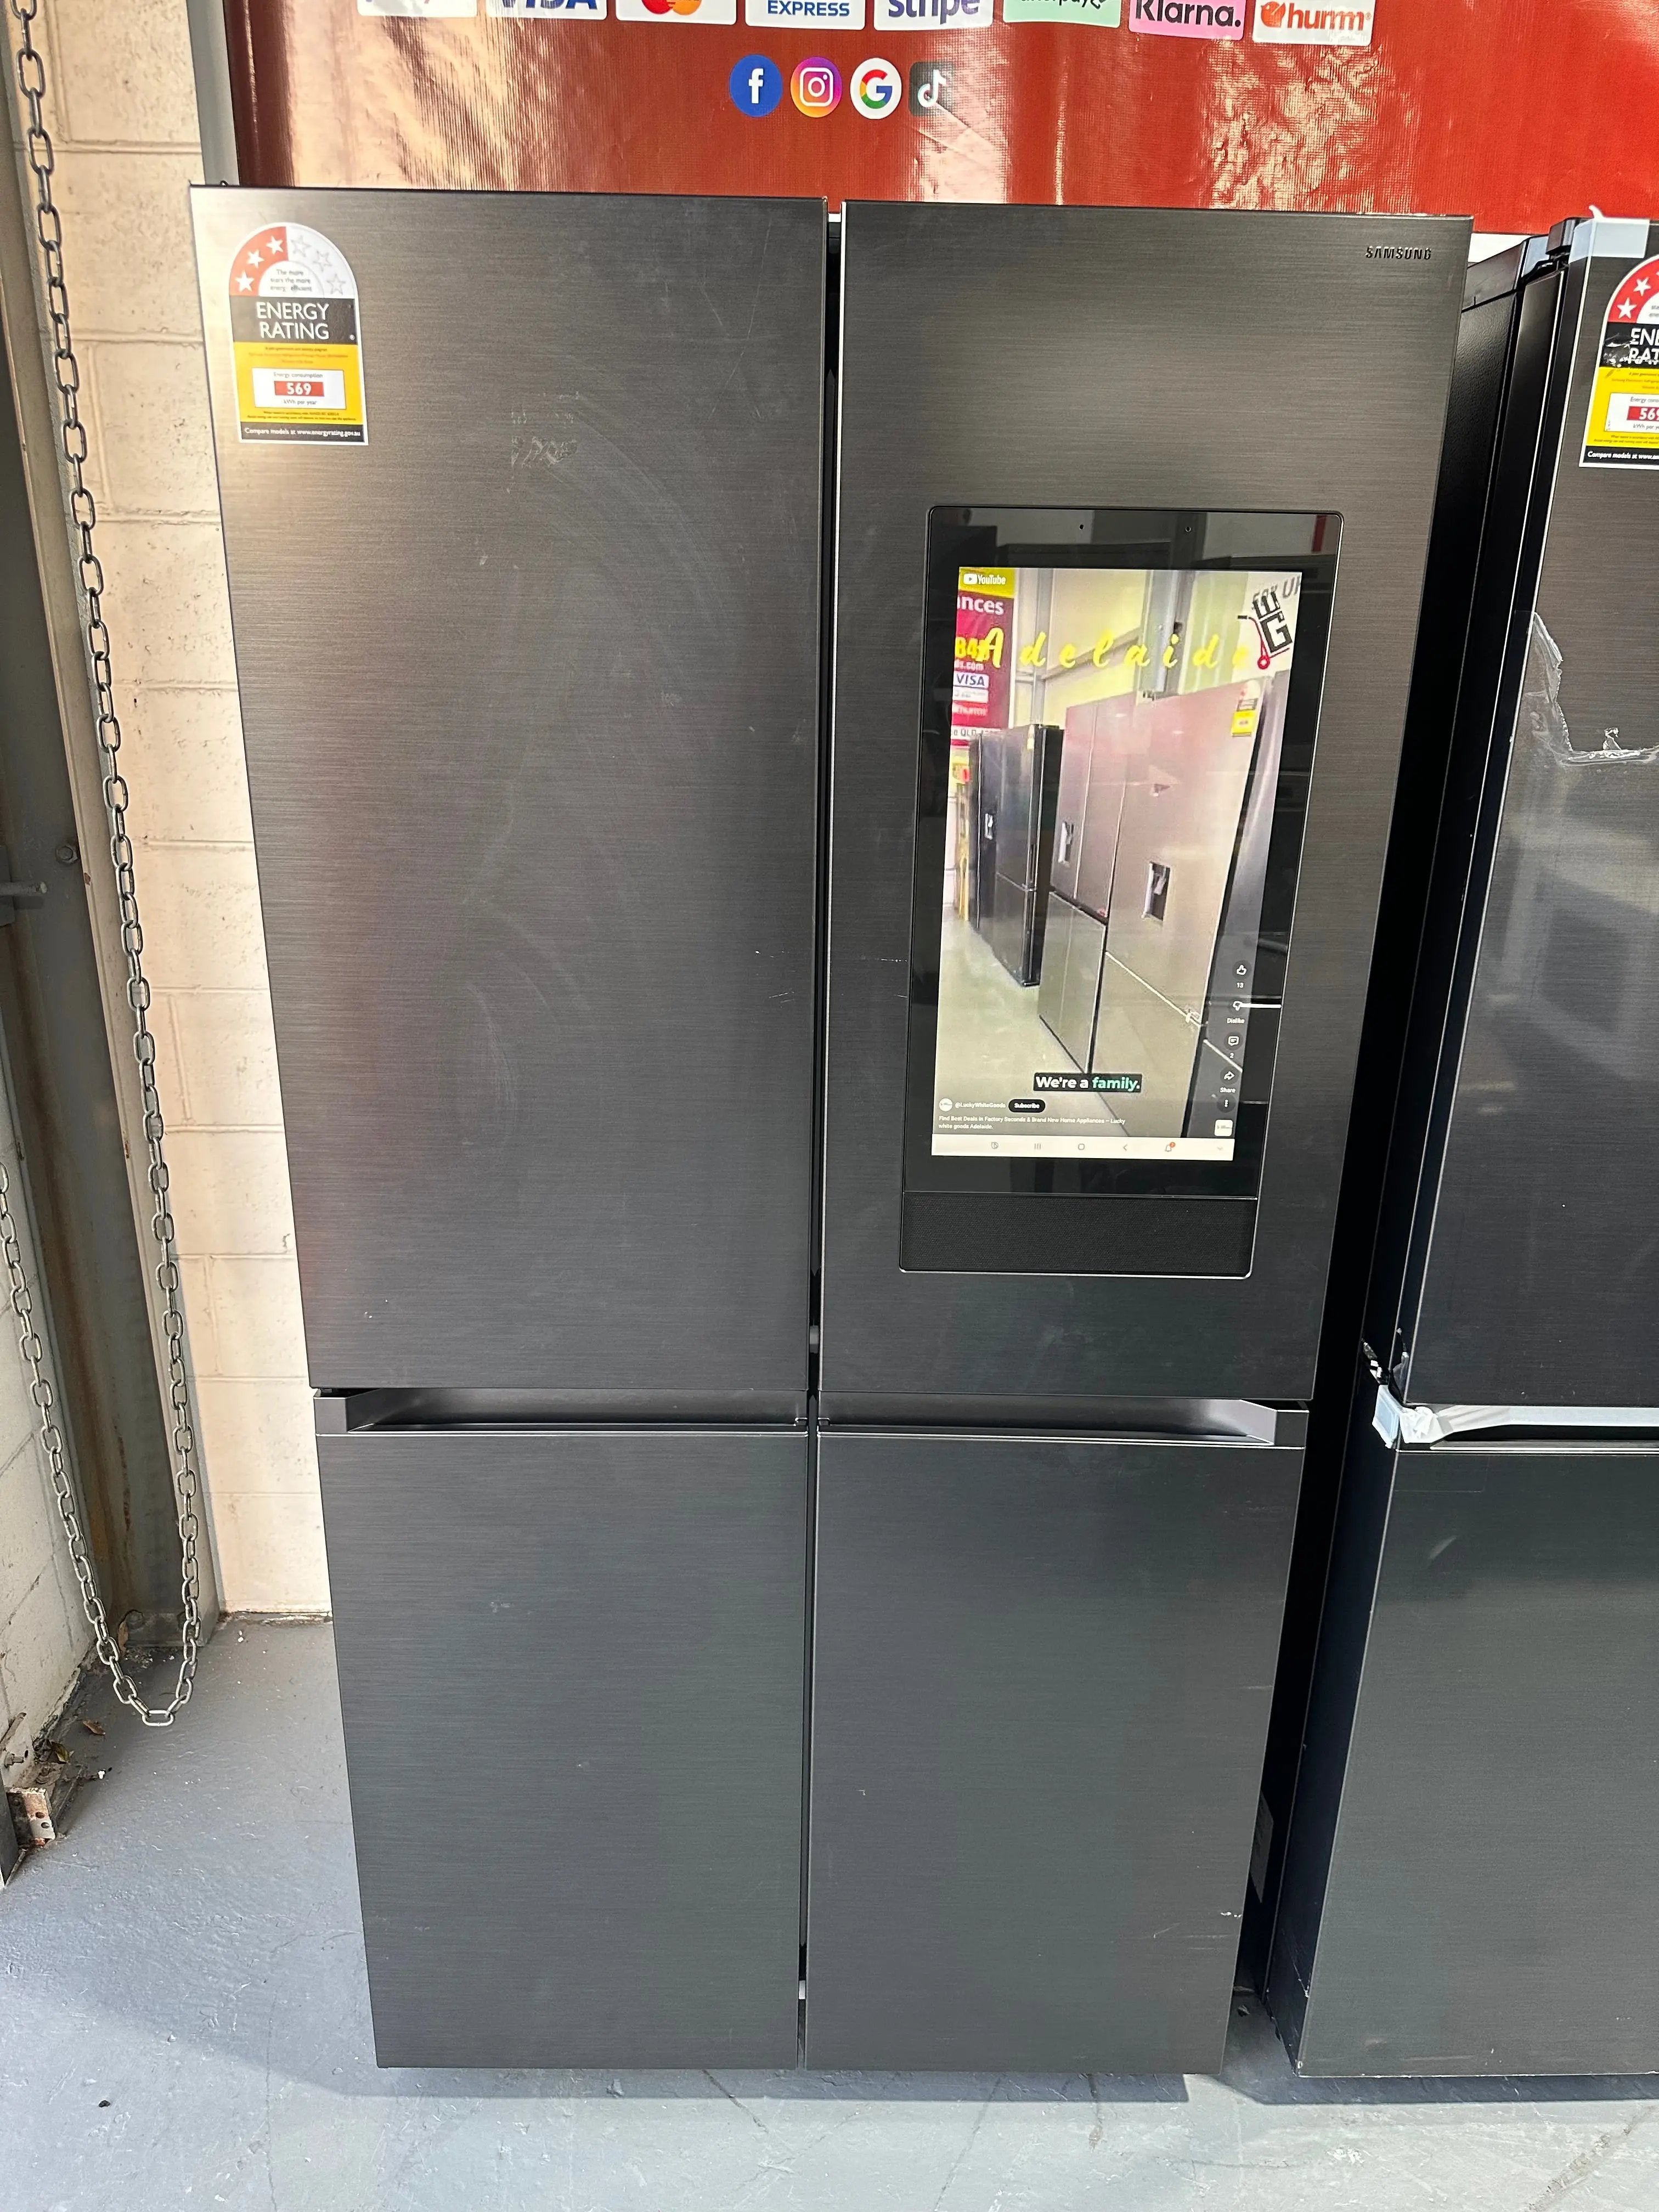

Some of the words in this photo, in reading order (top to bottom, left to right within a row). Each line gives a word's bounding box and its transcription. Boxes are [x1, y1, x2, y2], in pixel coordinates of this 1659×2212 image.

[768, 1, 849, 17] EXPRESS
[1365, 245, 1431, 259] SAMSUNG
[256, 301, 329, 321] ENERGY
[260, 322, 329, 340] RATING
[286, 382, 312, 395] 569
[1587, 451, 1612, 460] Compare
[977, 574, 1006, 585] YouTube
[956, 675, 985, 686] VISA
[1036, 1076, 1077, 1088] We're
[1079, 1079, 1088, 1088] a
[1092, 1076, 1140, 1092] family.
